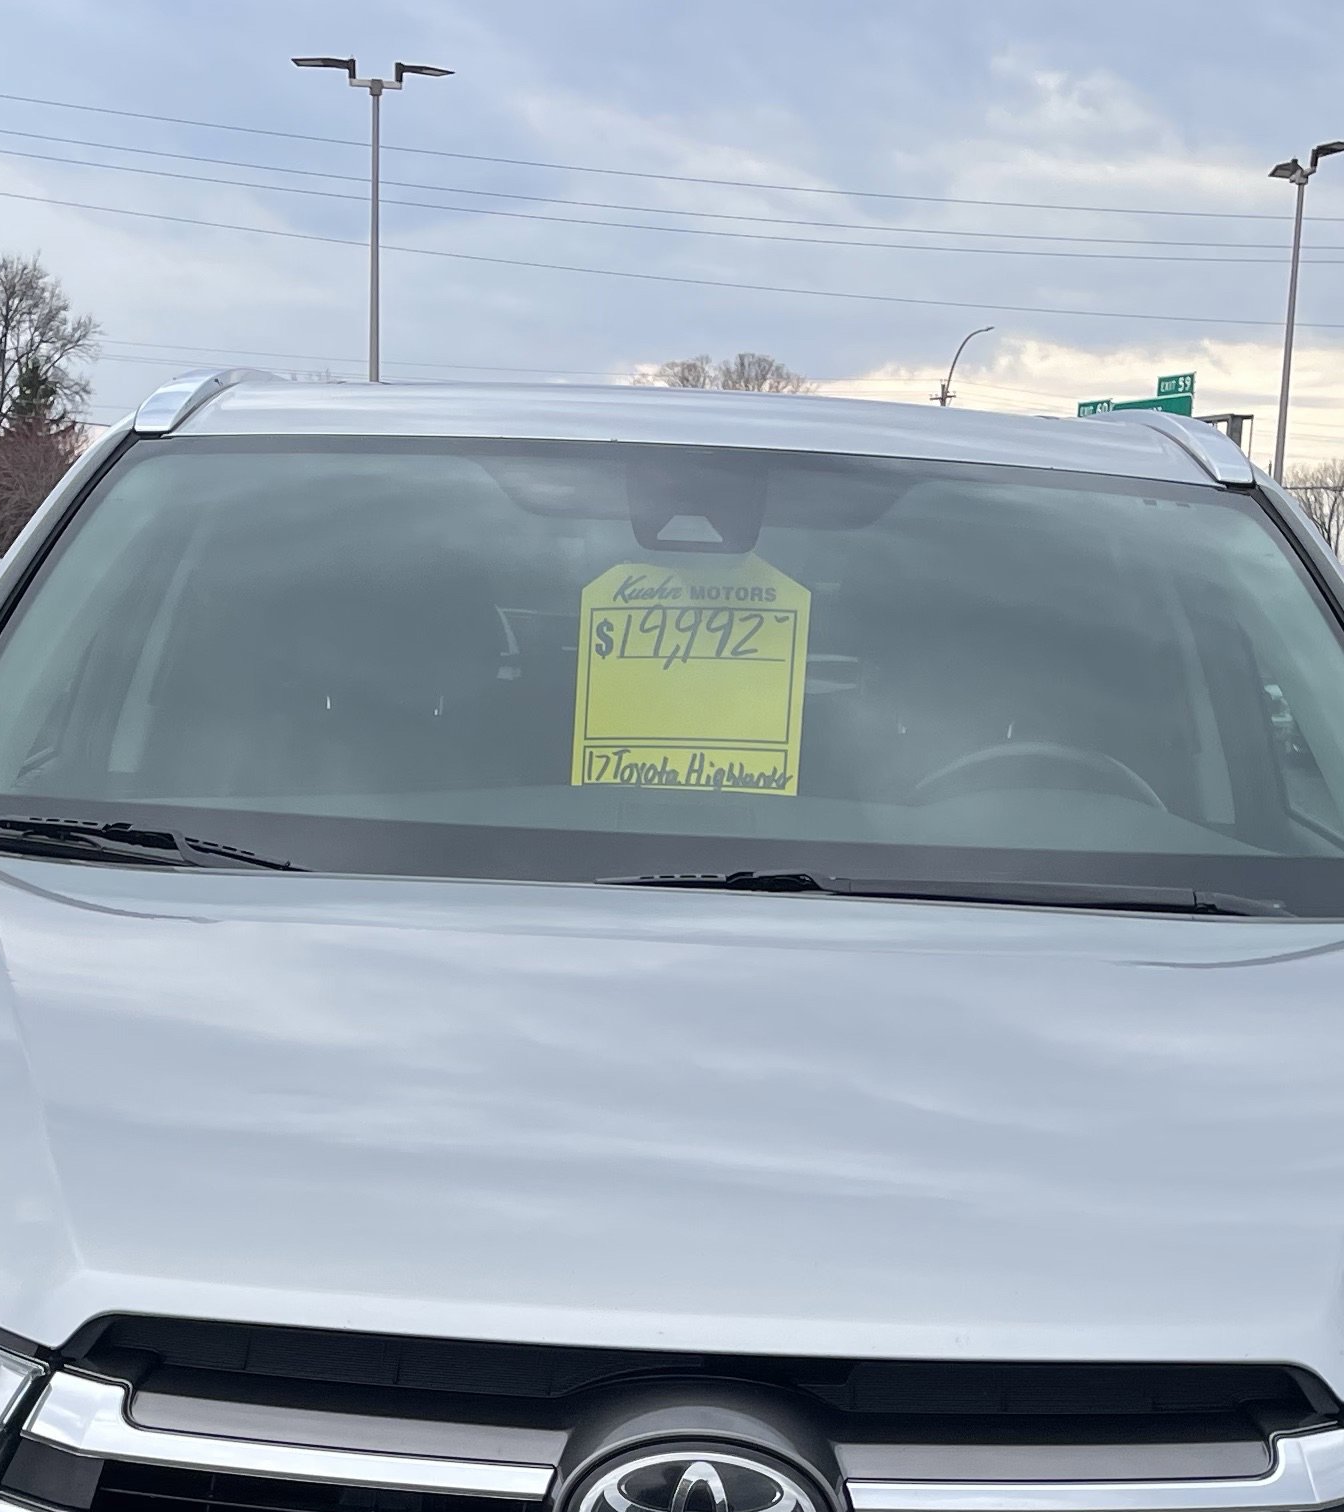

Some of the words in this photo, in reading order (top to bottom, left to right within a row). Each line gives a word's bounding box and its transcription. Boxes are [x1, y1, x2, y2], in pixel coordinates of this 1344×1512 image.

[1178, 376, 1191, 392] 59
[613, 574, 684, 604] Kuehn
[690, 585, 778, 603] MOTORS
